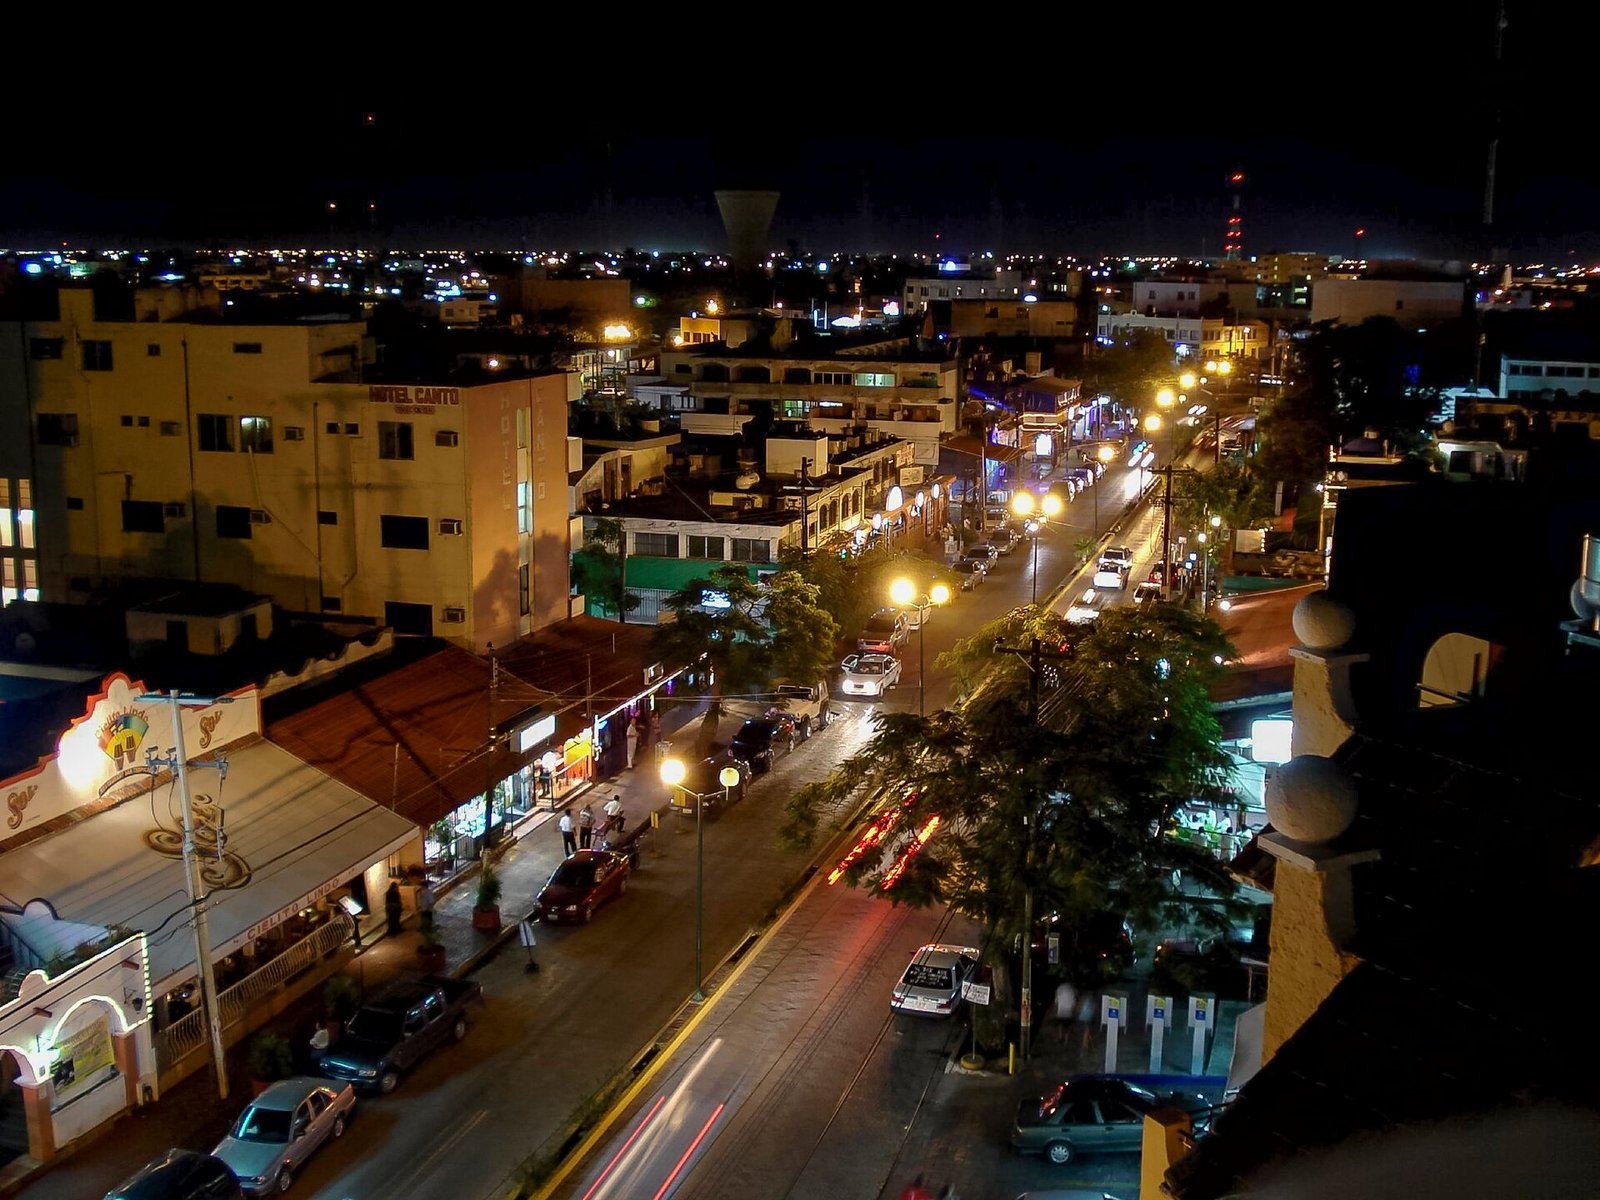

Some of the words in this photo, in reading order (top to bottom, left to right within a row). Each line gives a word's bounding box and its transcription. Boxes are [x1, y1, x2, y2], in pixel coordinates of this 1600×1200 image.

[369, 386, 413, 404] HOTEL
[414, 387, 460, 406] CANTO
[123, 704, 150, 722] Lindo
[246, 902, 300, 941] CIELITO
[306, 878, 340, 905] LINDO
